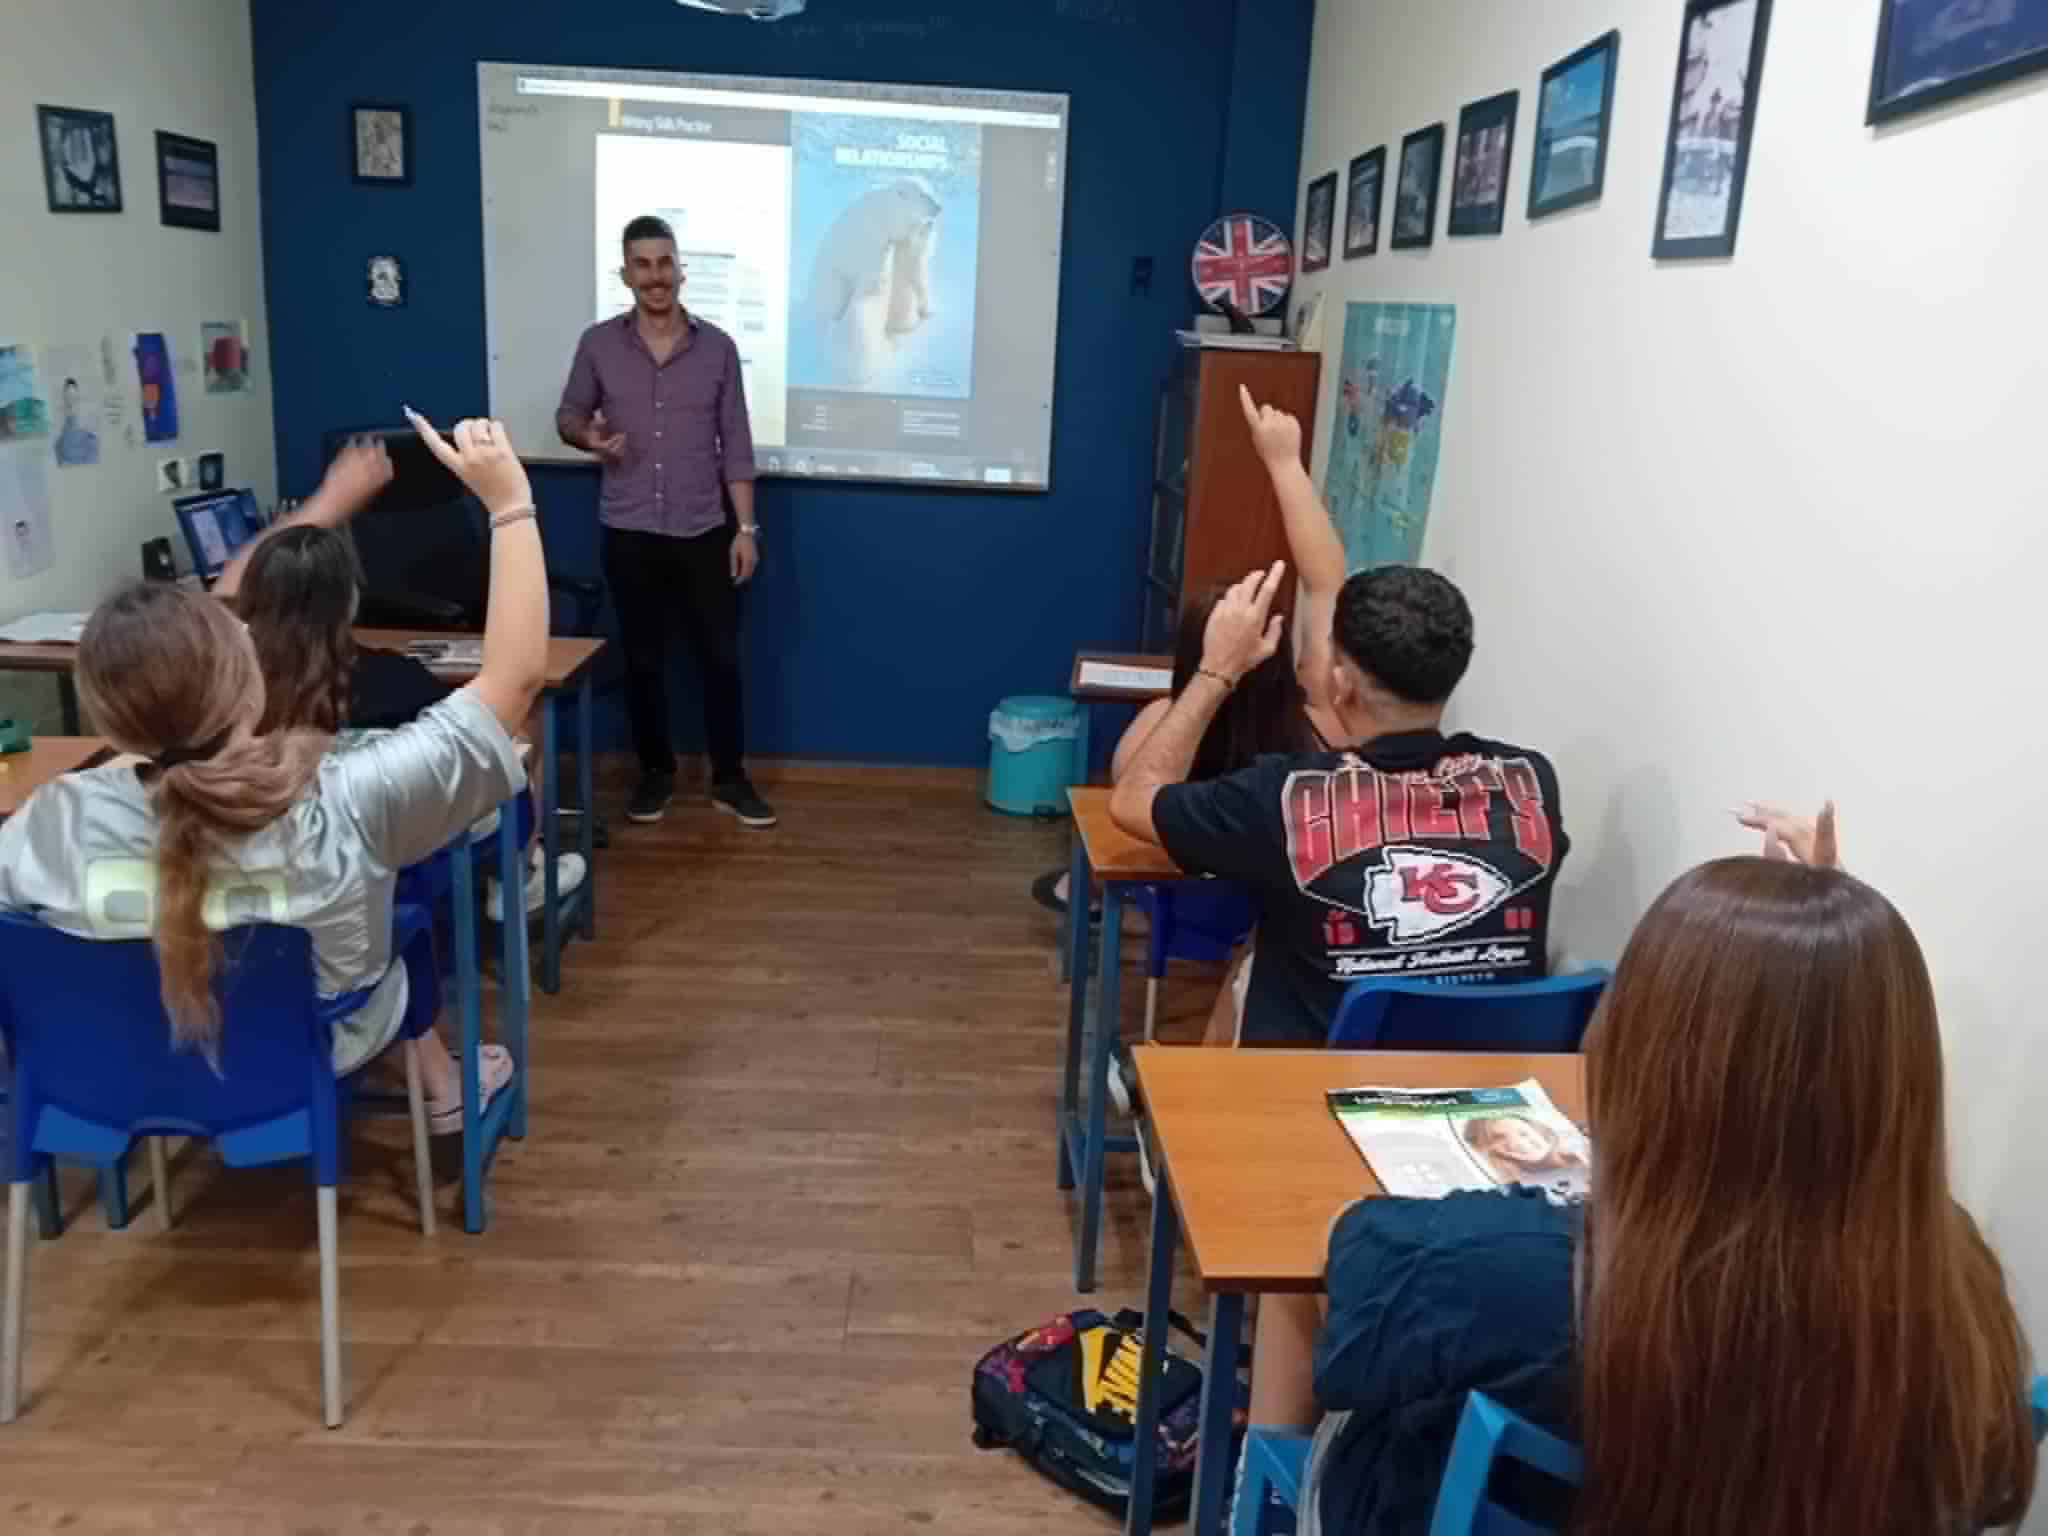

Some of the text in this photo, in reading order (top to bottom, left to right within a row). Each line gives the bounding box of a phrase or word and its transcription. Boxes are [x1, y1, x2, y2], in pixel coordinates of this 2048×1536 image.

[895, 132, 948, 153] SOCIAL
[1281, 756, 1553, 895] CHIEFS
[1398, 863, 1481, 915] KC
[1406, 946, 1478, 970] Football
